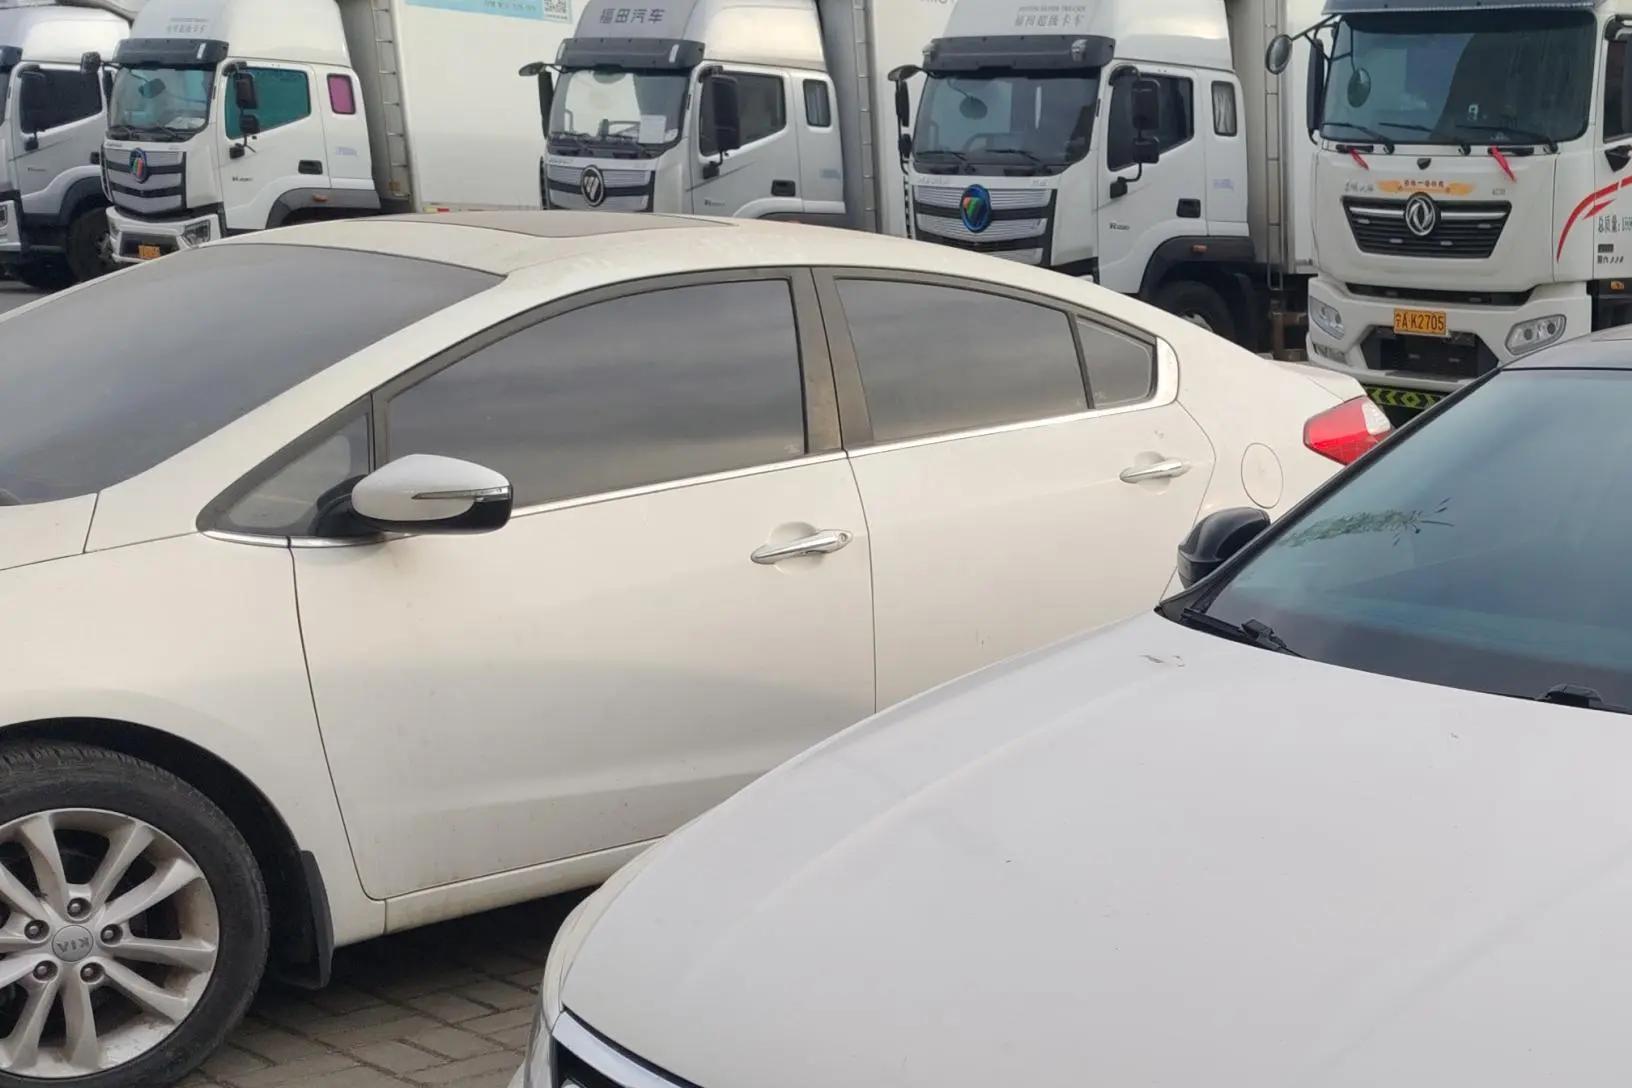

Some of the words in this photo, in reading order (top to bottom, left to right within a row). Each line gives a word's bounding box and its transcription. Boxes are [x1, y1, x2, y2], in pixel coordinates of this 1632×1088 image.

[600, 8, 665, 24] 福田汽车
[55, 936, 90, 953] KIA
